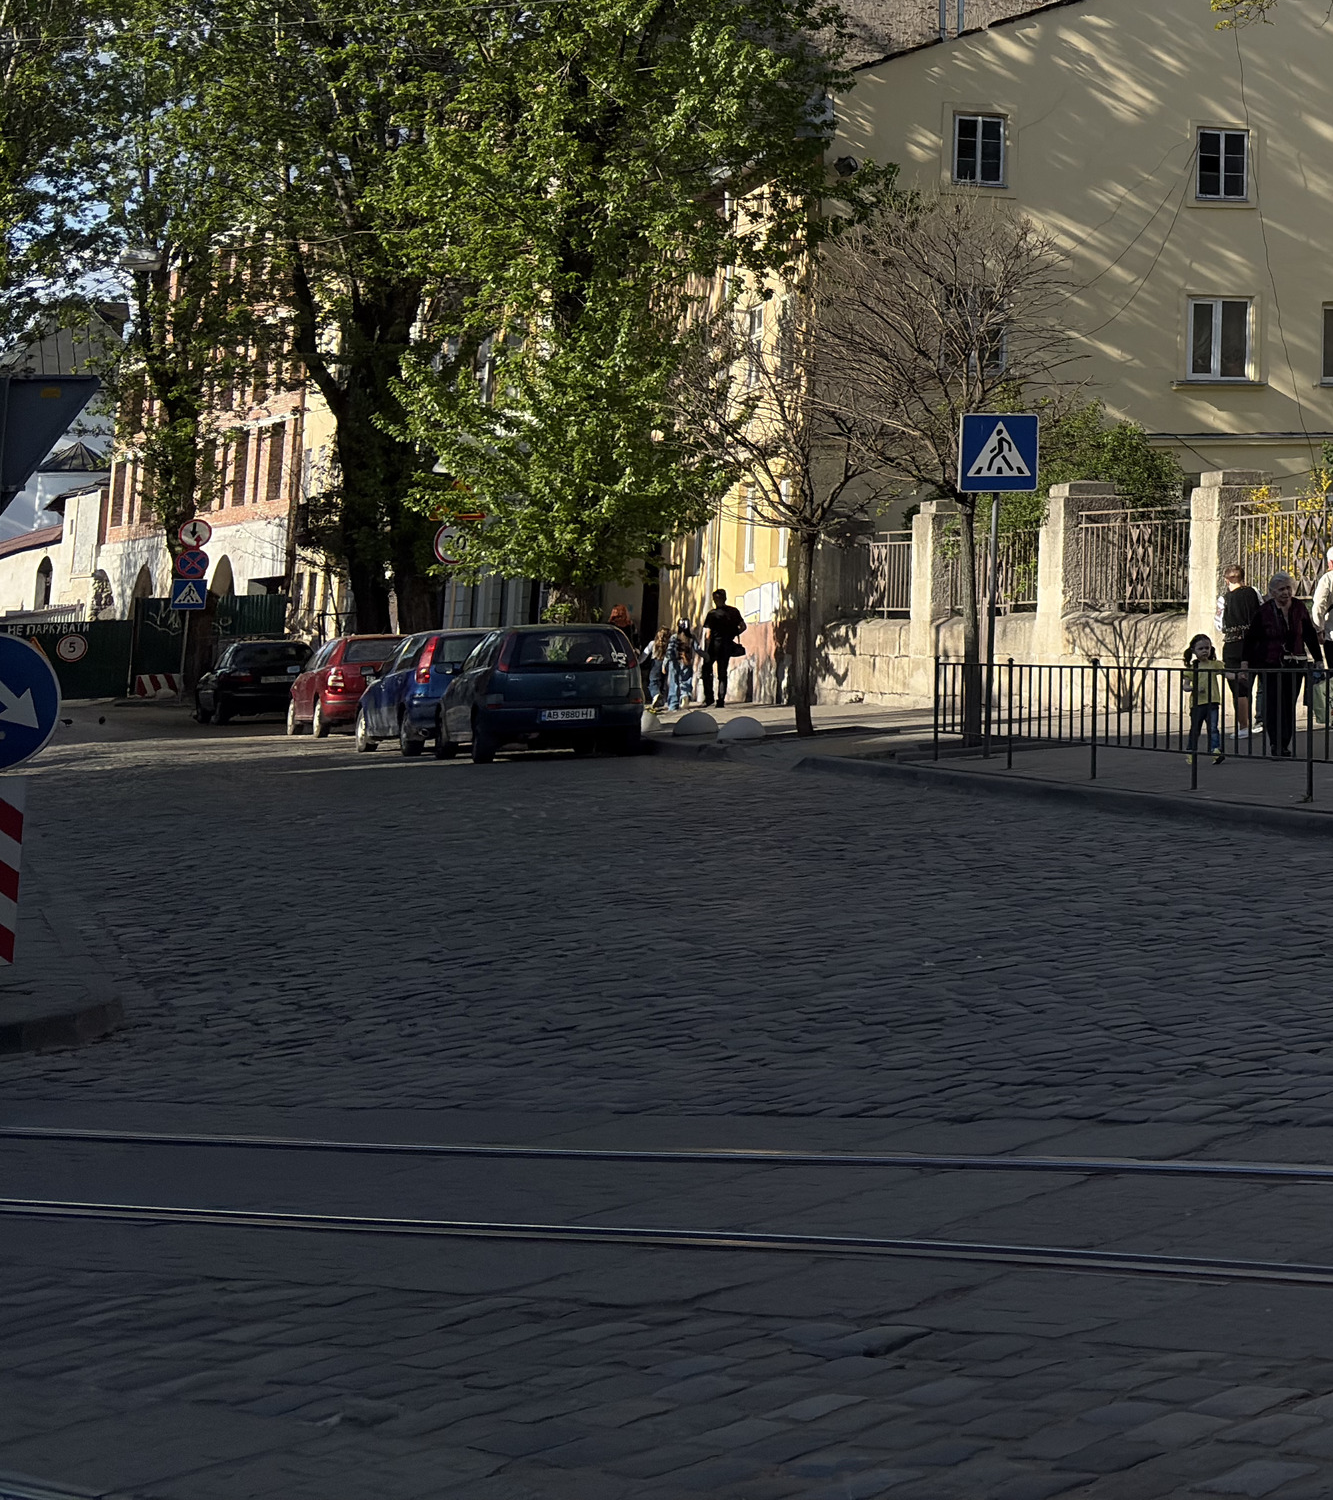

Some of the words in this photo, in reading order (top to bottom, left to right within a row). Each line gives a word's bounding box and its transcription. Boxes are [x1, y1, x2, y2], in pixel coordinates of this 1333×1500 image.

[7, 624, 24, 636] НЕ
[26, 622, 90, 636] ПАРКУВАТИ
[68, 642, 76, 653] 5
